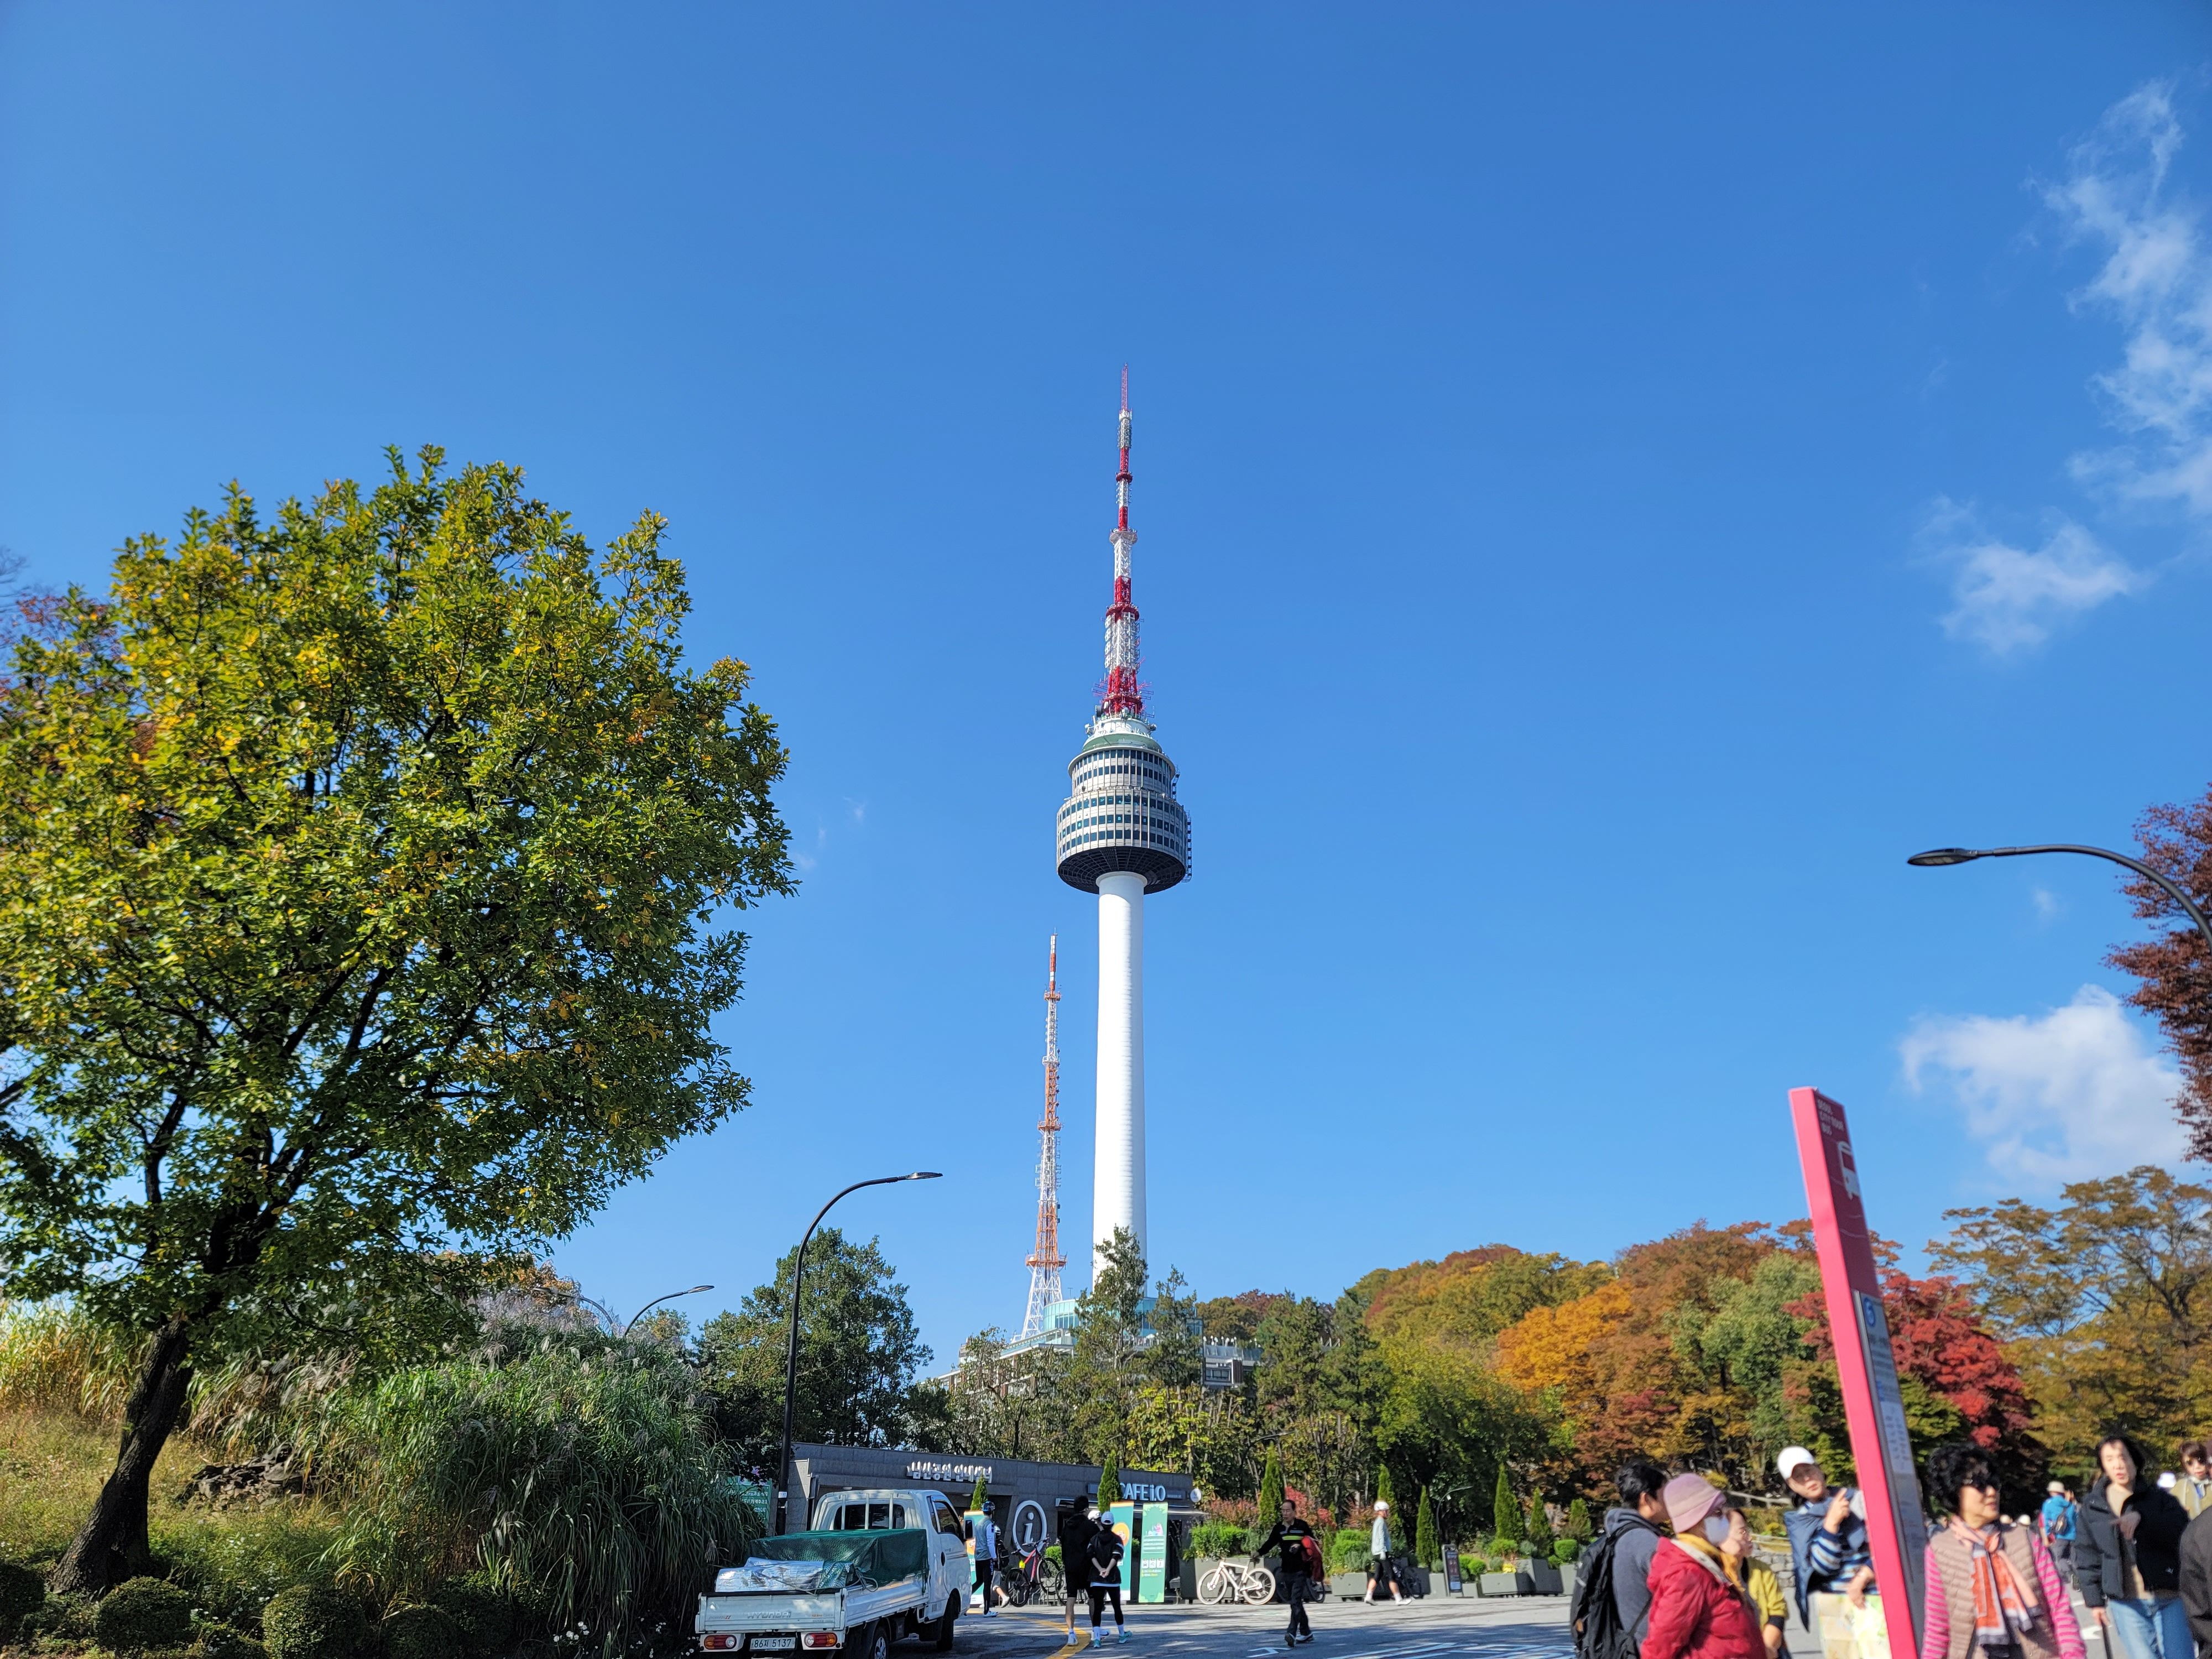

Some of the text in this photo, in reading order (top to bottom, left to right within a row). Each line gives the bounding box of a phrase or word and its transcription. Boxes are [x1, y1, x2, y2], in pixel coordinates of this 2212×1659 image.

[911, 1461, 992, 1483] 남산공원 안내센터
[772, 1639, 791, 1647] 5137
